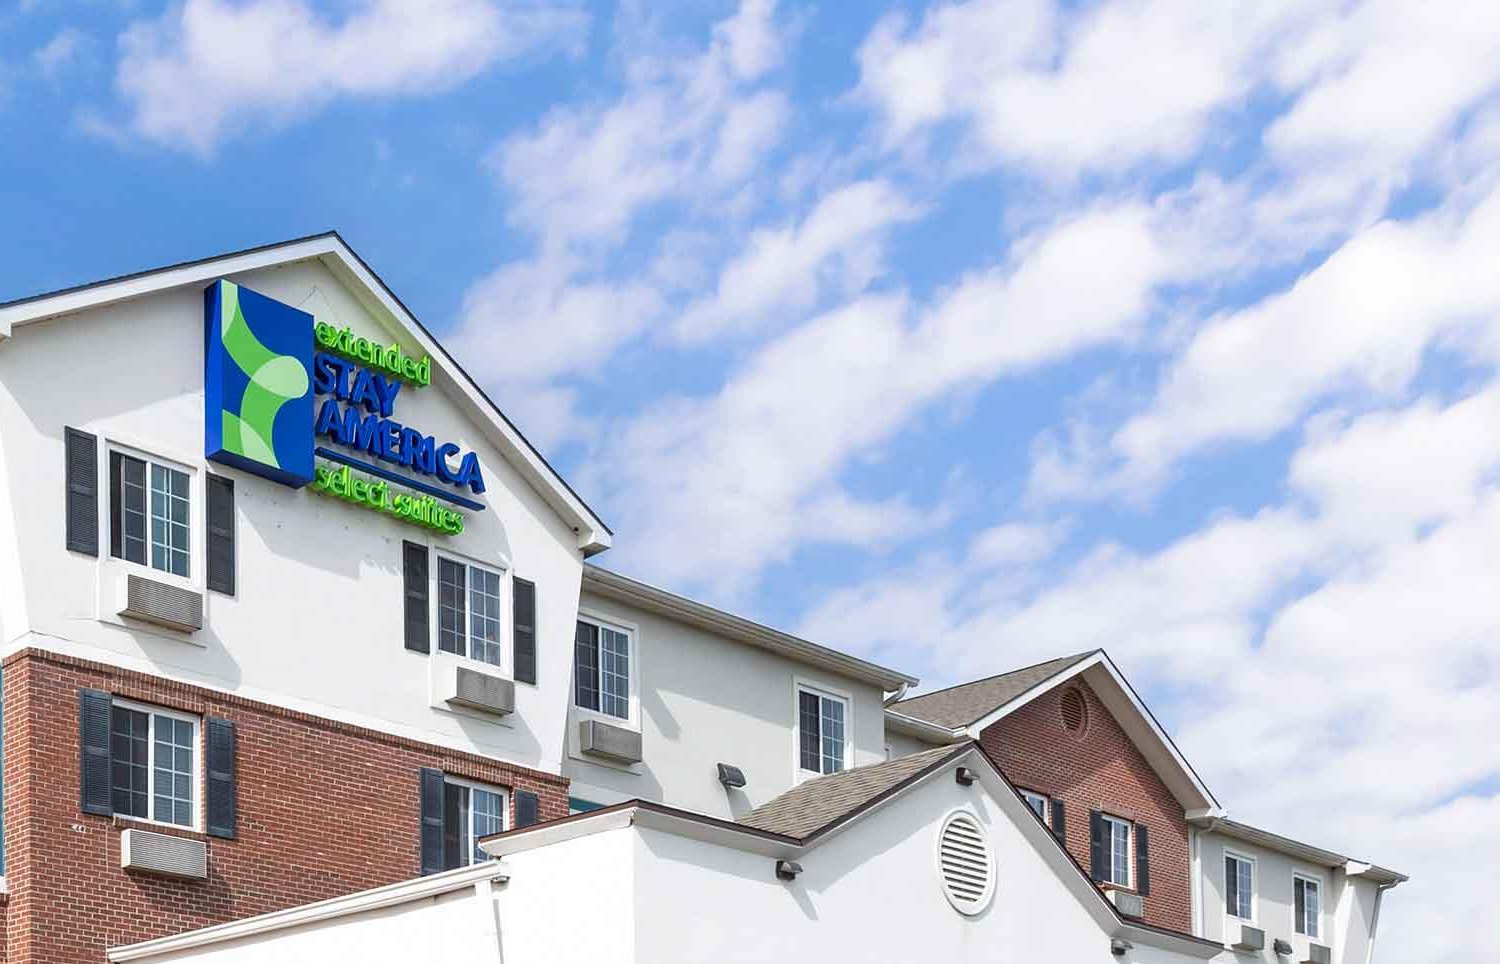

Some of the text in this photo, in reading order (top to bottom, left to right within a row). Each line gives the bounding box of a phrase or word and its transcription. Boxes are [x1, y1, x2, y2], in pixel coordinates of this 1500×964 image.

[314, 320, 432, 388] extended
[314, 351, 403, 417] STAY
[316, 399, 486, 494] AMERICA
[312, 464, 466, 536] select suites
